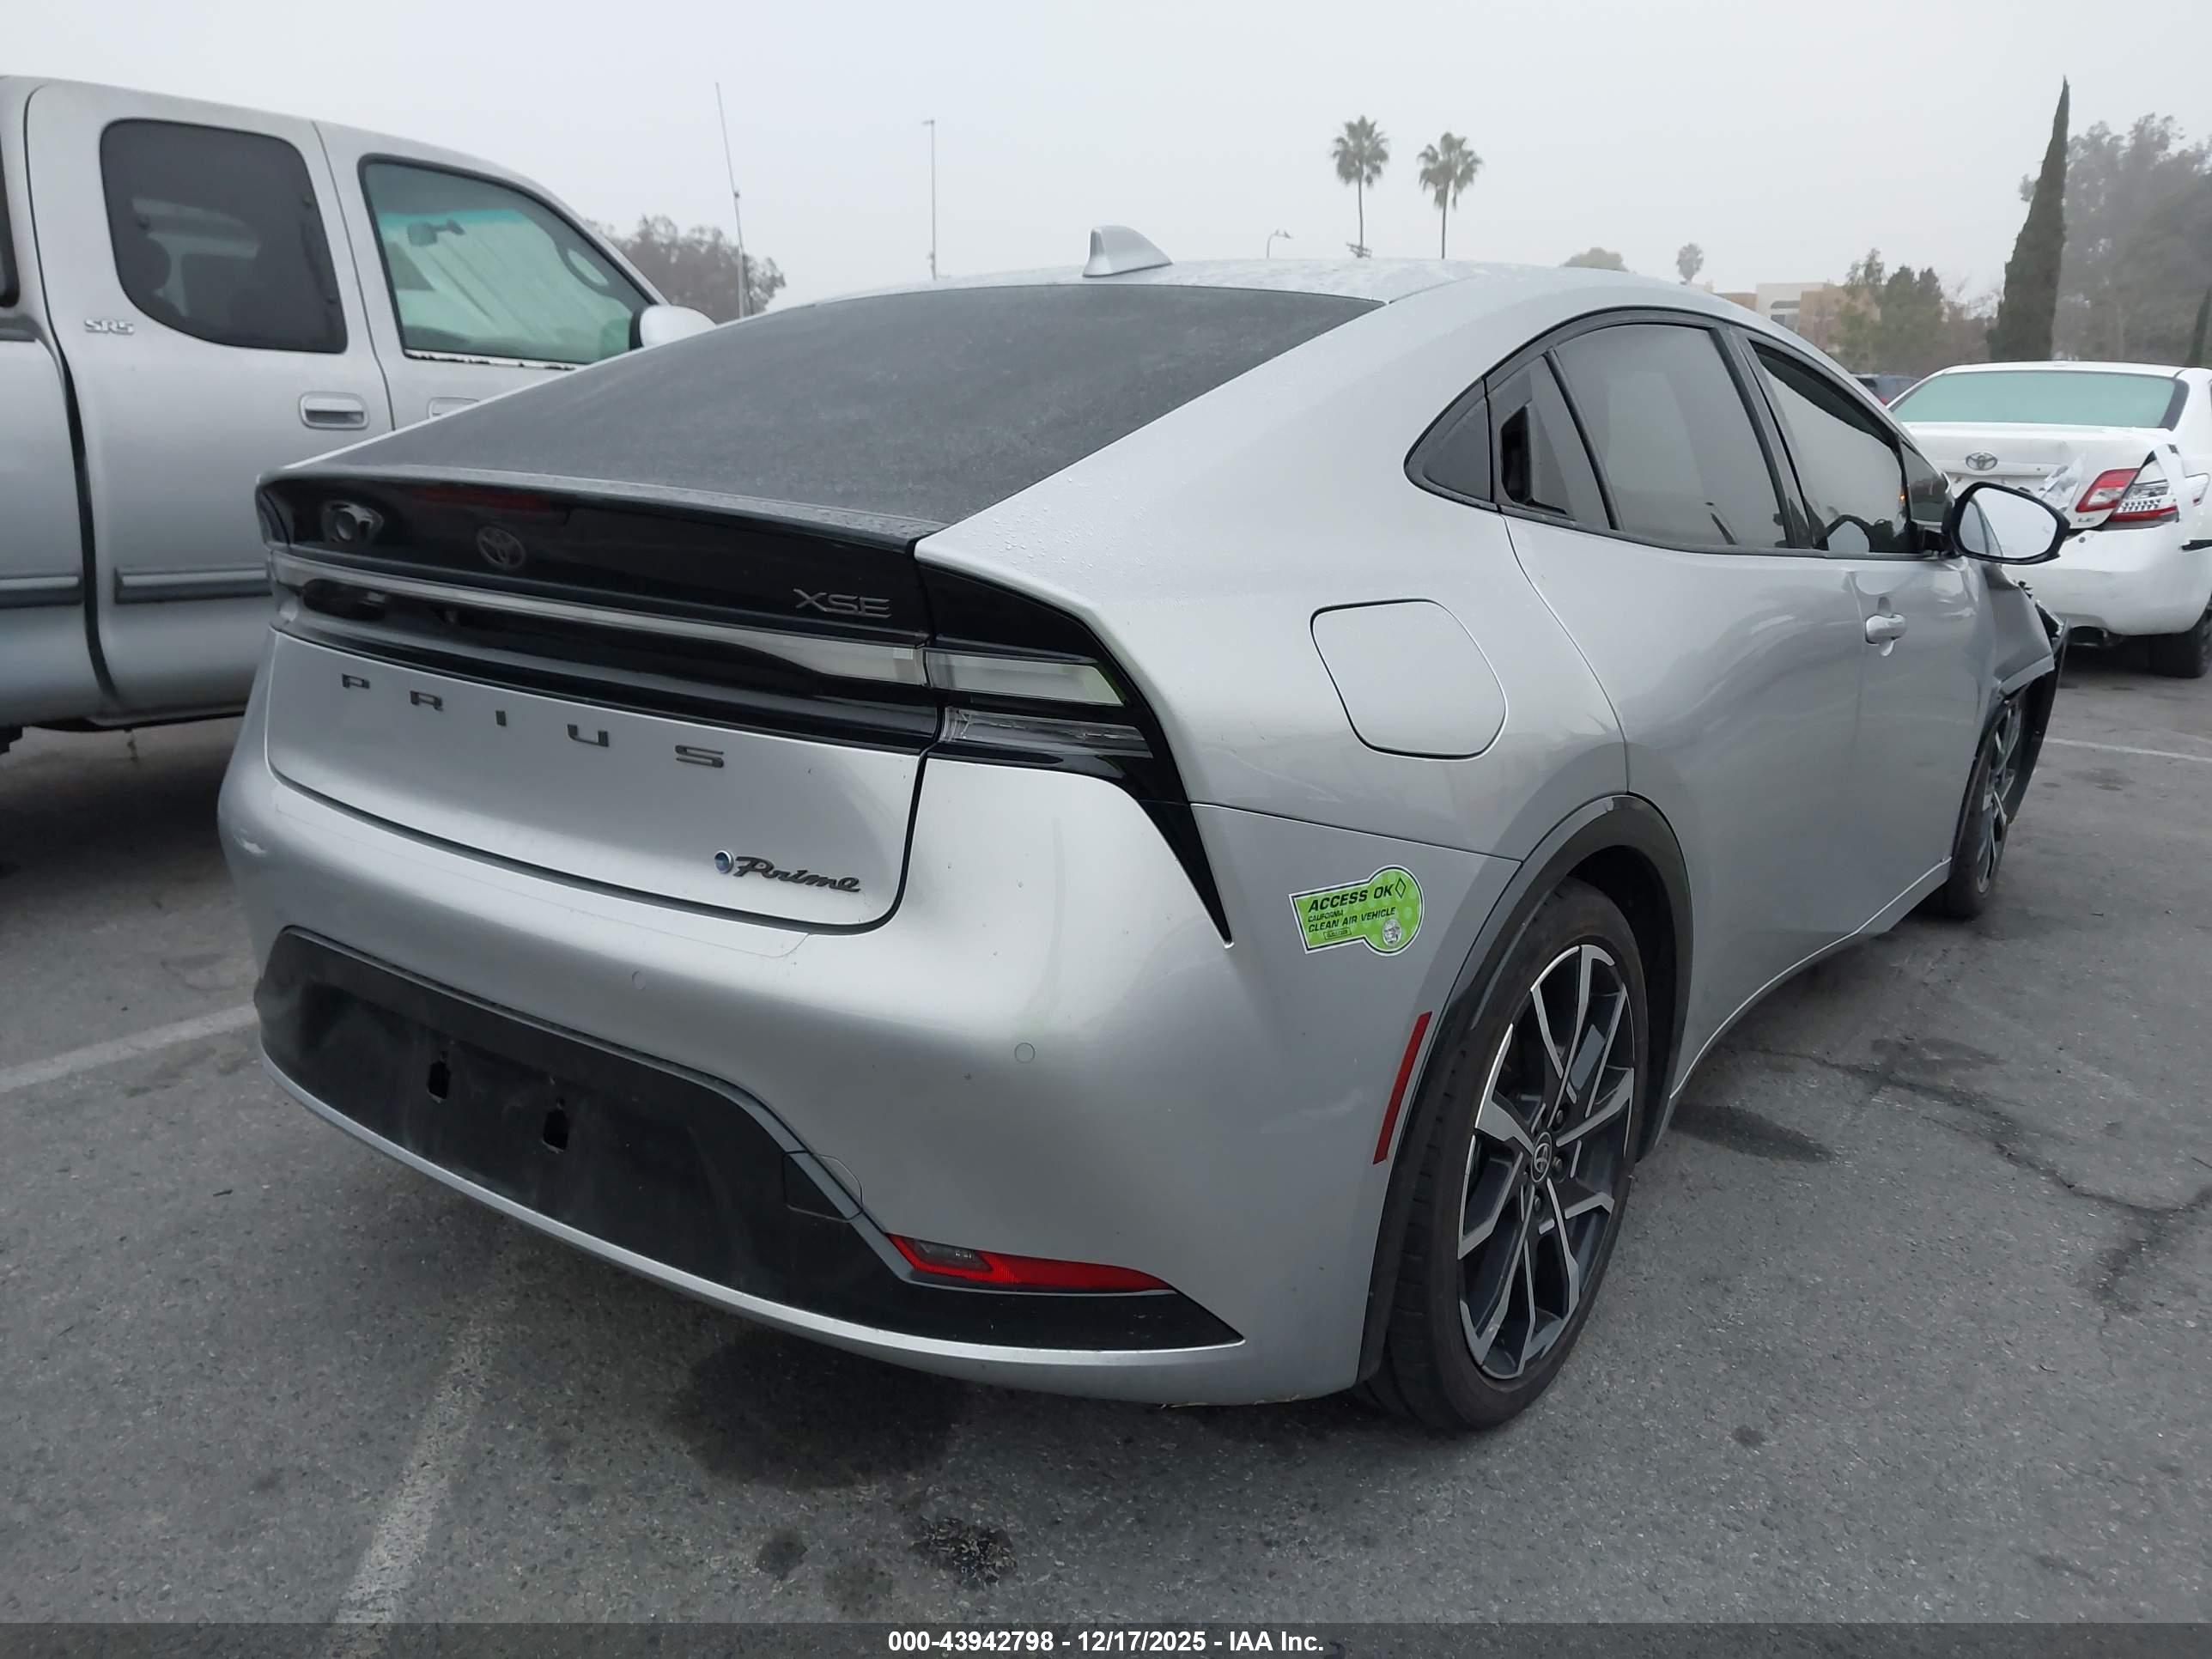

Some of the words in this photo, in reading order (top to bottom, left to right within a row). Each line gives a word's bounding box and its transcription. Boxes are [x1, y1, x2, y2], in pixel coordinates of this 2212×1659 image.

[793, 588, 892, 618] XSE
[342, 673, 724, 769] PRIUS
[733, 856, 860, 892] Prime
[1308, 890, 1368, 913] ACCESS
[1373, 884, 1395, 899] OK
[1308, 909, 1344, 923] CALIFORNIA
[1308, 920, 1340, 933] CLEAN
[1342, 915, 1357, 927] AIR
[1361, 907, 1396, 922] VEHICLE
